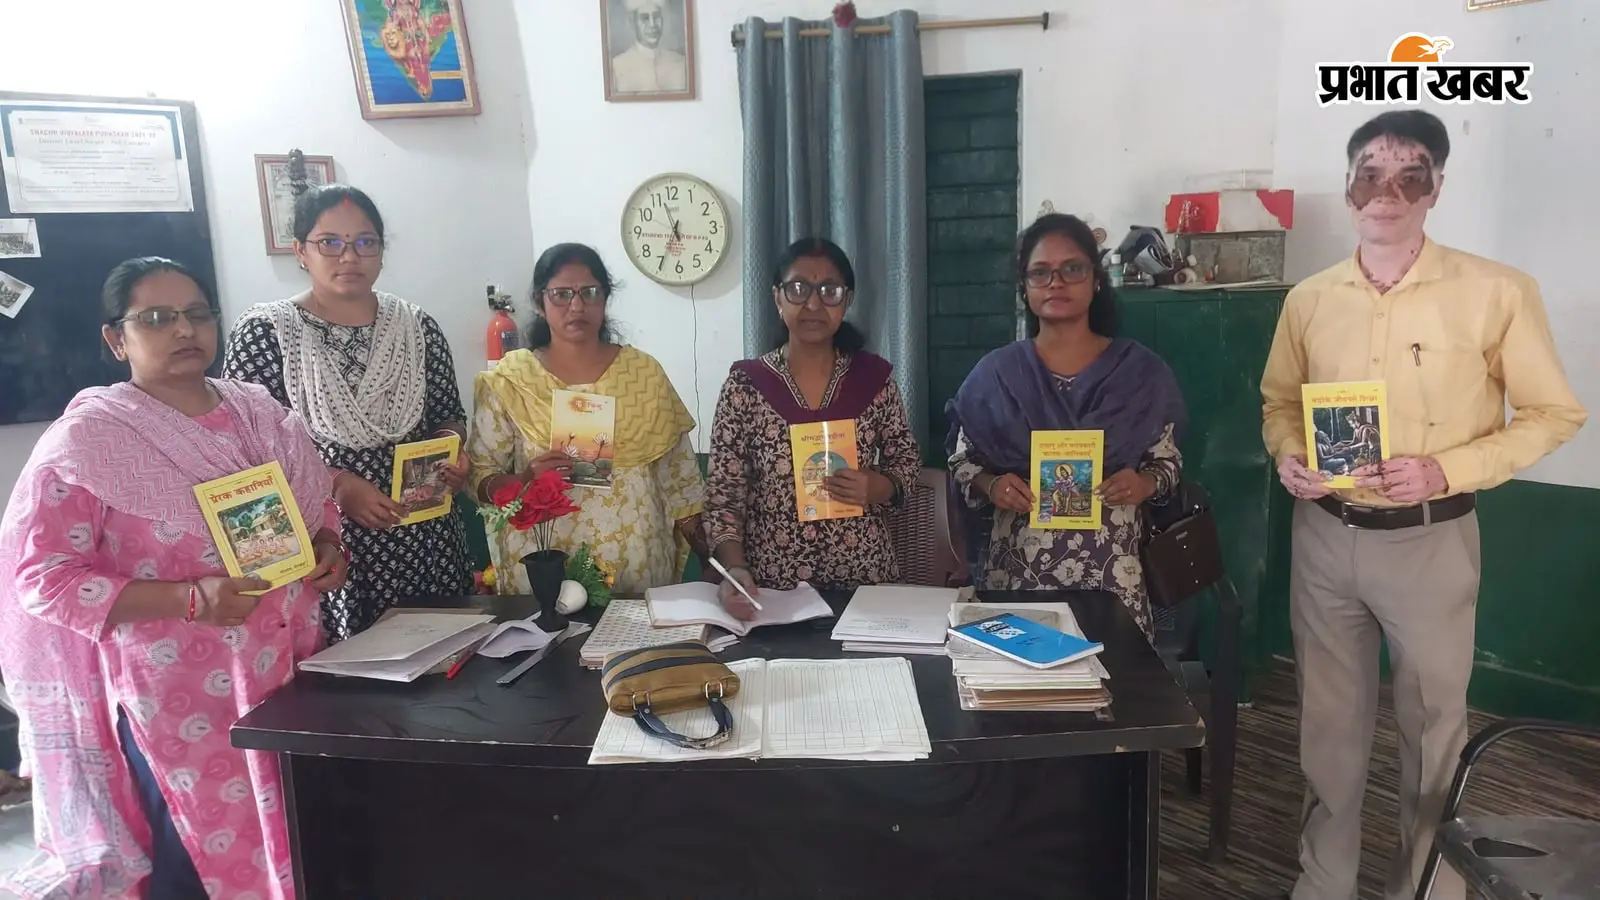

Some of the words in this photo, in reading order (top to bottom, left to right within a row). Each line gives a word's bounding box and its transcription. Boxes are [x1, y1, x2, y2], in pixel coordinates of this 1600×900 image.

[665, 186, 679, 200] 12
[688, 189, 693, 204] 1
[650, 193, 662, 208] 11
[639, 208, 652, 222] 10
[700, 202, 710, 216] 2
[633, 225, 642, 239] 9
[709, 220, 718, 234] 3
[642, 244, 651, 258] 8
[704, 239, 713, 253] 4
[656, 256, 665, 272] 7
[675, 260, 683, 274] 6
[692, 254, 701, 268] 5
[209, 491, 232, 505] प्रेरक
[233, 475, 274, 496] कहानियाँ
